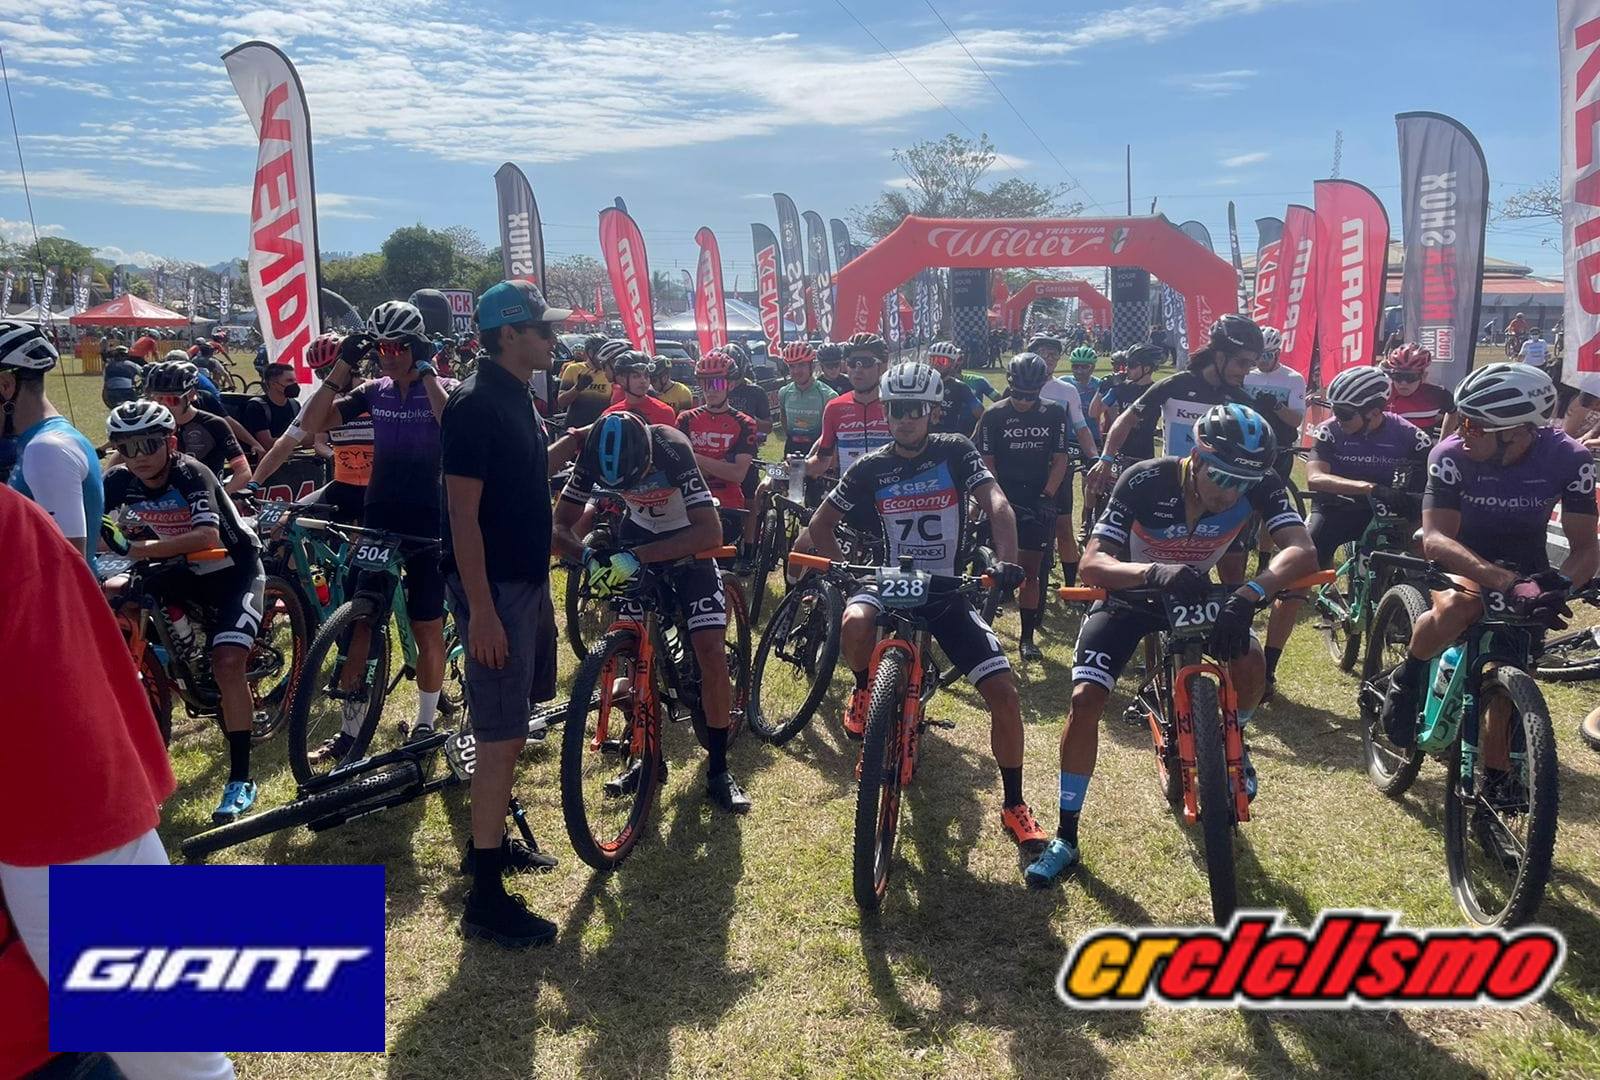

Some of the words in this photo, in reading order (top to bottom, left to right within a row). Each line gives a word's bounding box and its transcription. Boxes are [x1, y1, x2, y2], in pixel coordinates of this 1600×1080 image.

[928, 227, 1105, 257] Wilier
[450, 294, 471, 313] OCK
[1003, 427, 1050, 437] xerox
[879, 475, 901, 485] NEO
[902, 479, 940, 492] CBZ
[1128, 467, 1161, 490] FORCE
[882, 495, 951, 510] Economy
[895, 514, 943, 541] 7C
[356, 545, 390, 563] 504
[881, 579, 924, 597] 238
[689, 597, 714, 614] 7C
[1172, 601, 1221, 627] 230
[1083, 649, 1112, 670] 7C
